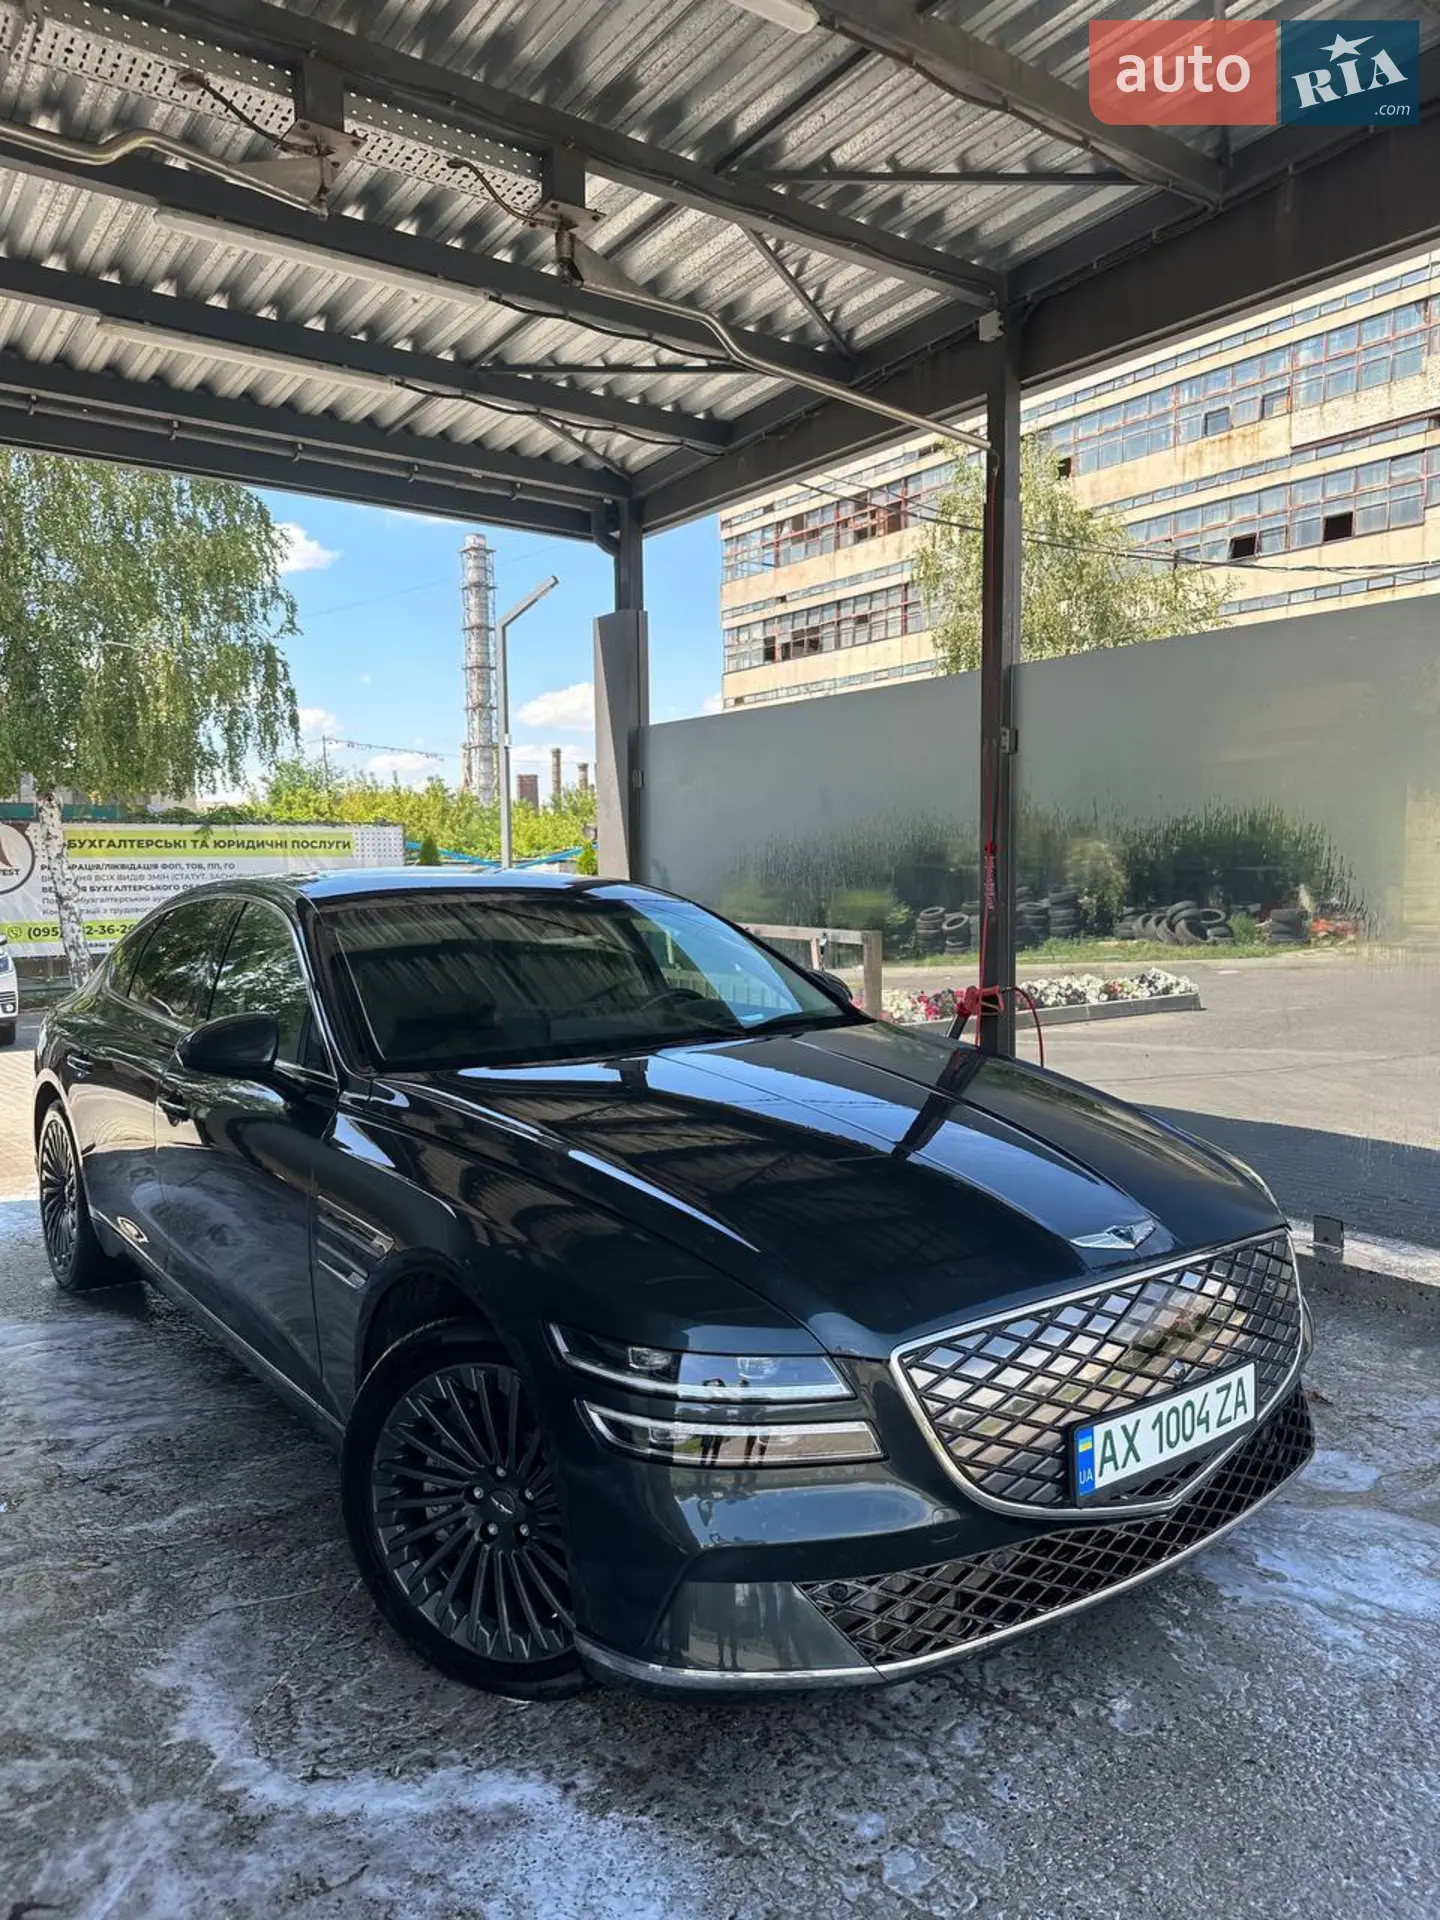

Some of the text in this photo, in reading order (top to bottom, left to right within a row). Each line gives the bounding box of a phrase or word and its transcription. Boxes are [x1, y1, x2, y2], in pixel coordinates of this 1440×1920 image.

[67, 839, 351, 850] БУХГАЛТЕРСЬКІ ТА ЮРИДИЧНІ ПОСЛУГИ
[160, 863, 185, 871] ФОП,
[186, 863, 206, 871] ТОВ,
[207, 863, 223, 871] ПП,
[224, 862, 236, 870] ГО
[89, 884, 181, 892] БУХГАЛТЕРСЬКОГО
[1098, 1376, 1248, 1478] AX 1004 ZA
[1079, 1471, 1094, 1485] UA
